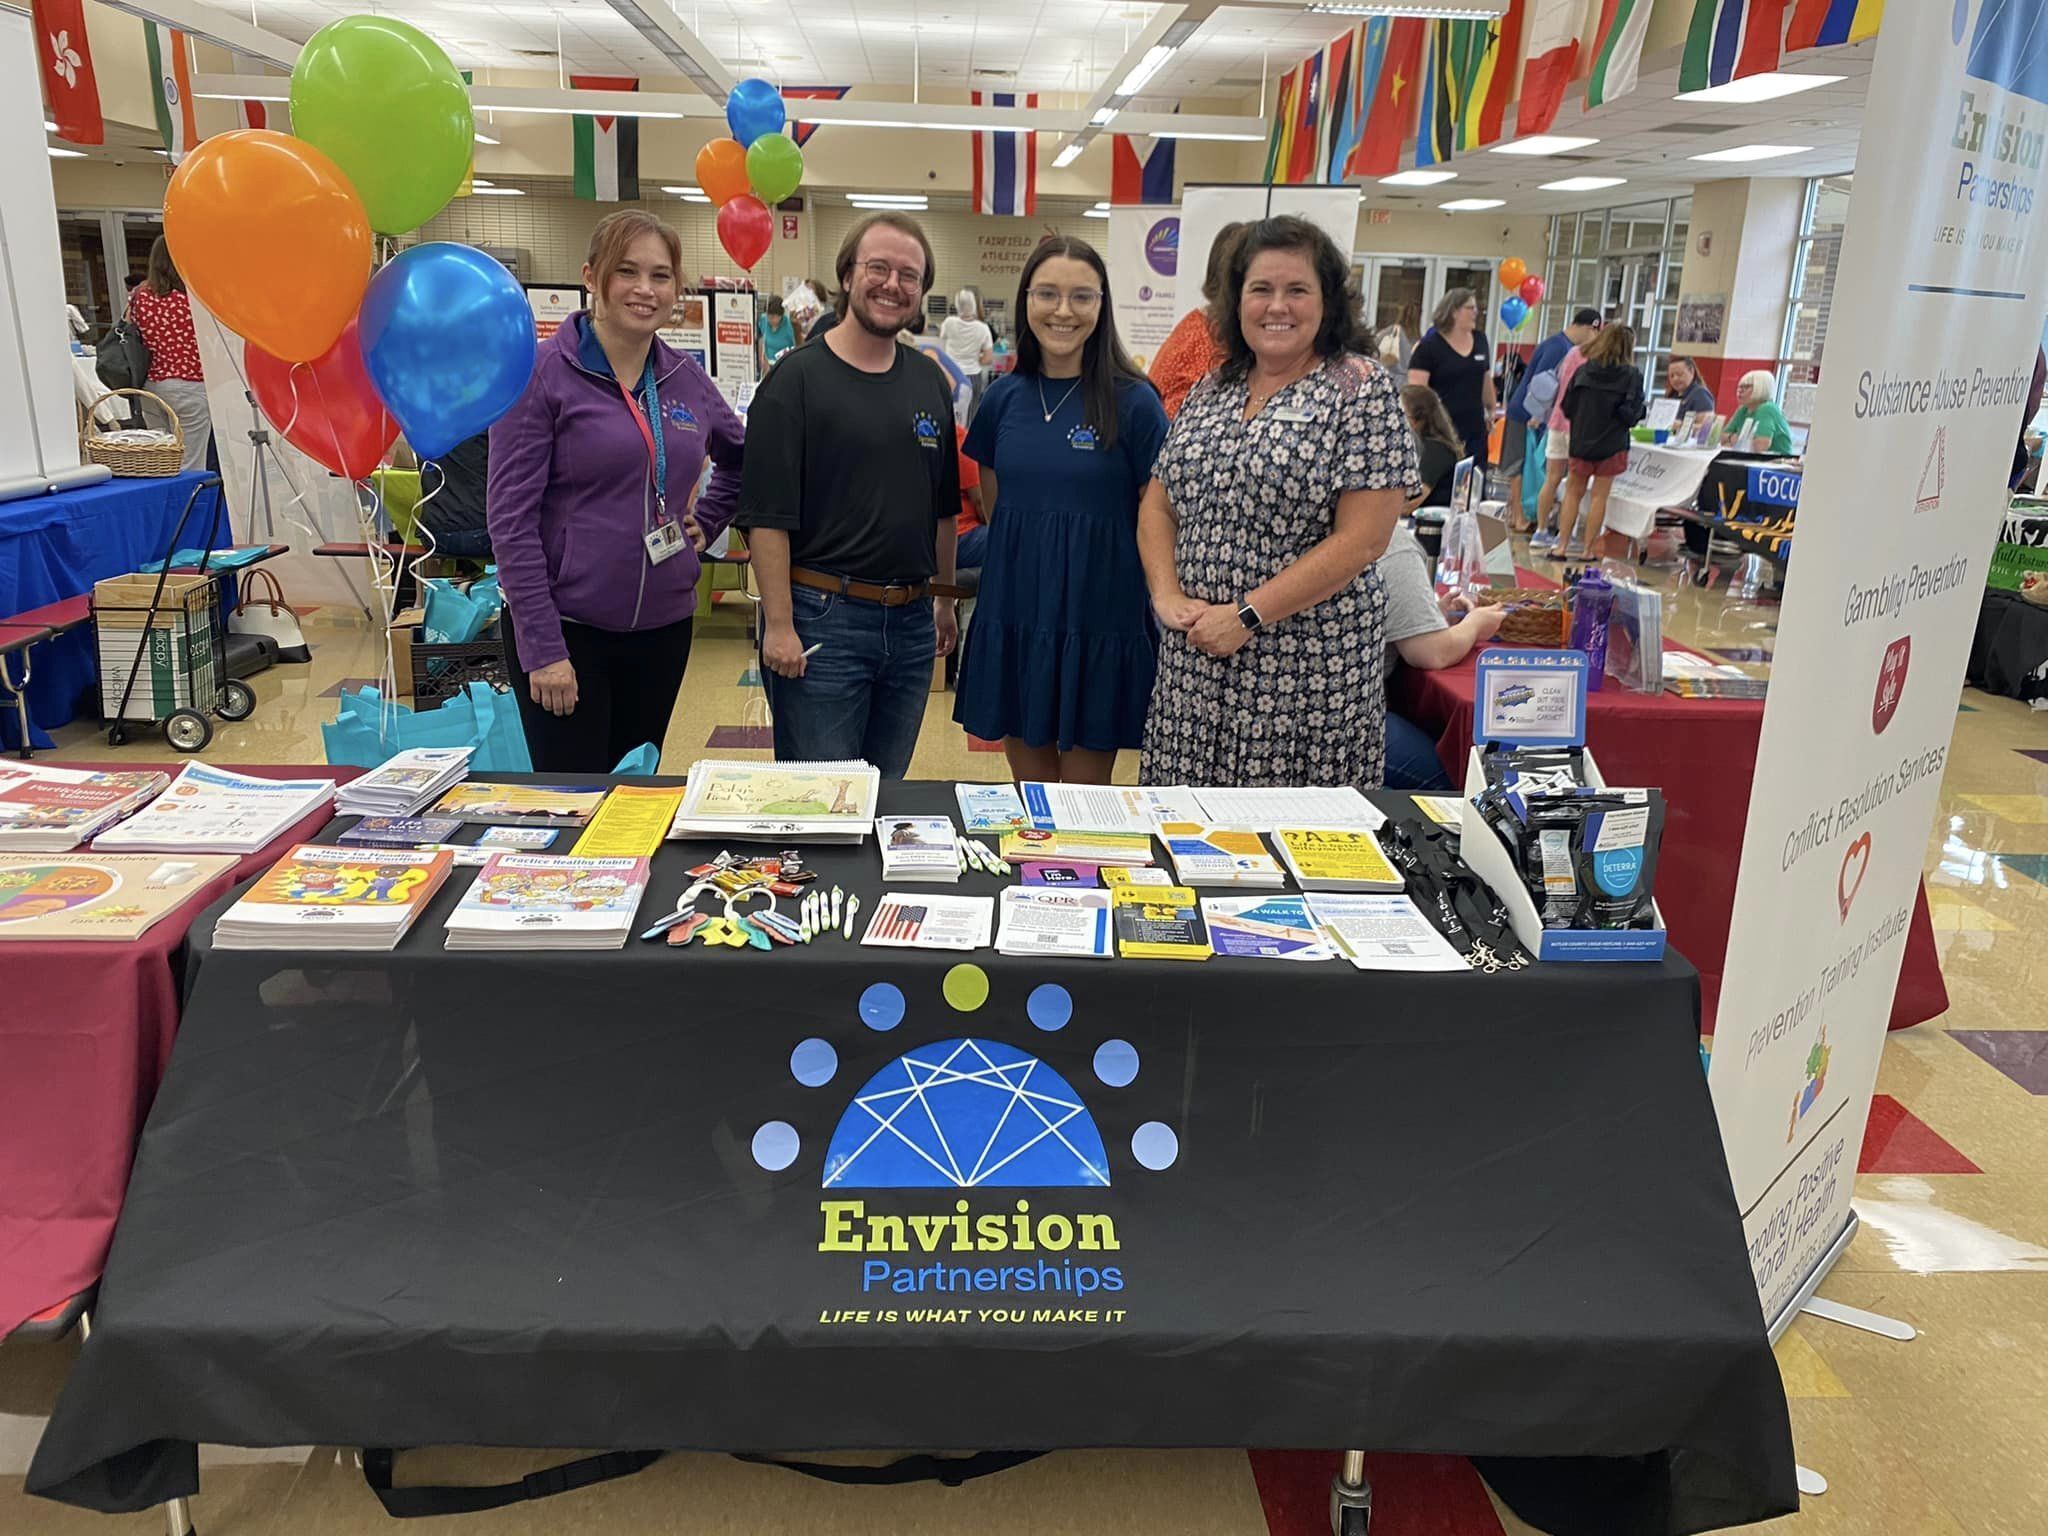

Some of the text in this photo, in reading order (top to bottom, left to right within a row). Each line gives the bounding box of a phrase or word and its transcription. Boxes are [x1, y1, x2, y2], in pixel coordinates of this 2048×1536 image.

[1952, 90, 2045, 170] Enision
[1957, 161, 2034, 221] Panerships
[977, 235, 1032, 247] FAIRFIELD
[1854, 366, 2031, 419] Substance Abuse Prevention
[1844, 552, 1968, 627] Gambling Prevention
[1541, 687, 1561, 695] CLEAN
[1781, 746, 1946, 873] Conflict Resolution Services
[504, 856, 550, 866] Practice
[552, 858, 595, 867] Healthy
[598, 858, 633, 867] Habits
[1038, 895, 1078, 906] QPR
[1745, 906, 1908, 1072] Prevention Training Institute
[1793, 1138, 1845, 1216] Positive
[818, 1199, 1121, 1252] Envision
[1792, 1173, 1838, 1251] Health
[862, 1257, 1125, 1298] Partnerships
[819, 1309, 1127, 1324] LIFE IS WHAT YOU MAKE IT
